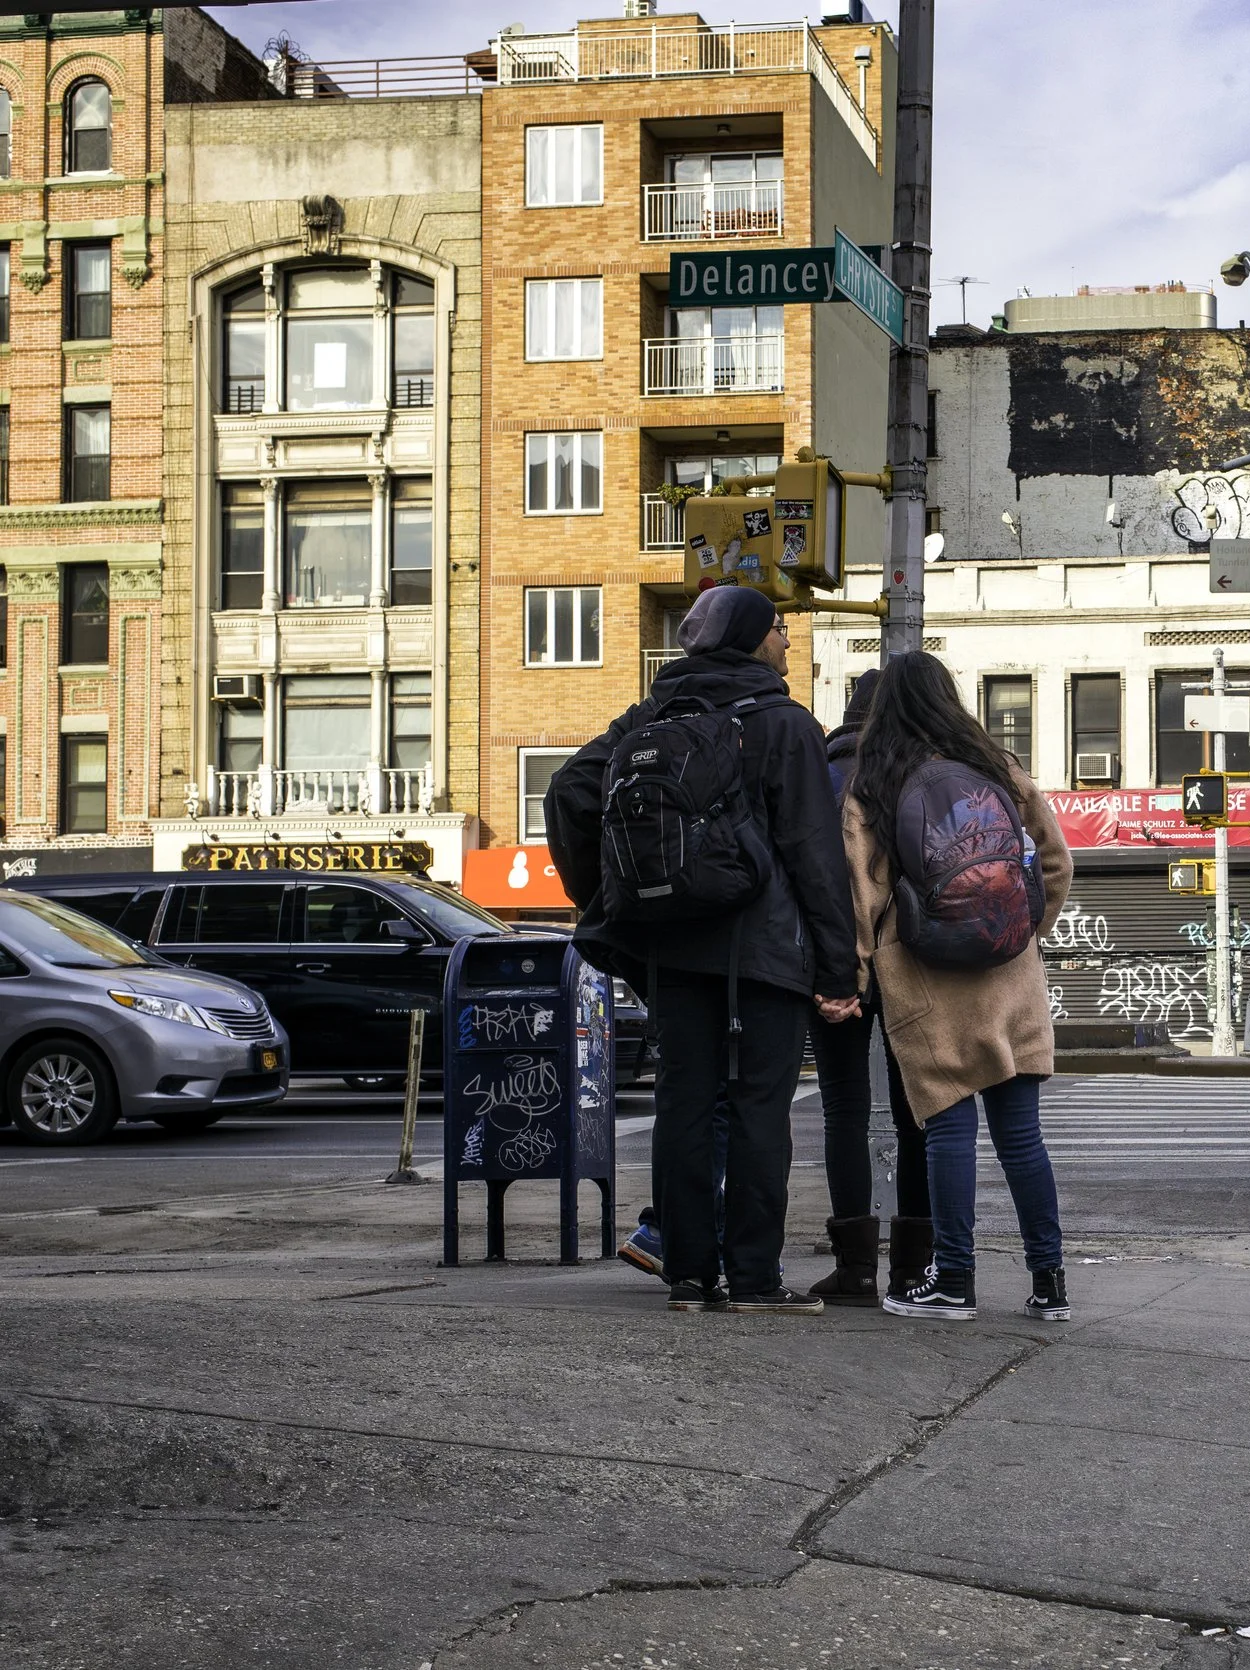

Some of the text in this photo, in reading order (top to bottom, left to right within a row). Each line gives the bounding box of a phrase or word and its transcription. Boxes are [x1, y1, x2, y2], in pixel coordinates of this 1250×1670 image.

[680, 256, 835, 301] Delancey
[840, 242, 890, 327] CHRYSTIE
[739, 556, 758, 568] dig
[632, 750, 657, 761] GRIP
[1047, 795, 1142, 815] AVAILABLE
[1118, 820, 1141, 828] JAIME
[1143, 820, 1176, 828] SCHULTZ
[208, 845, 404, 871] PATISSERIE
